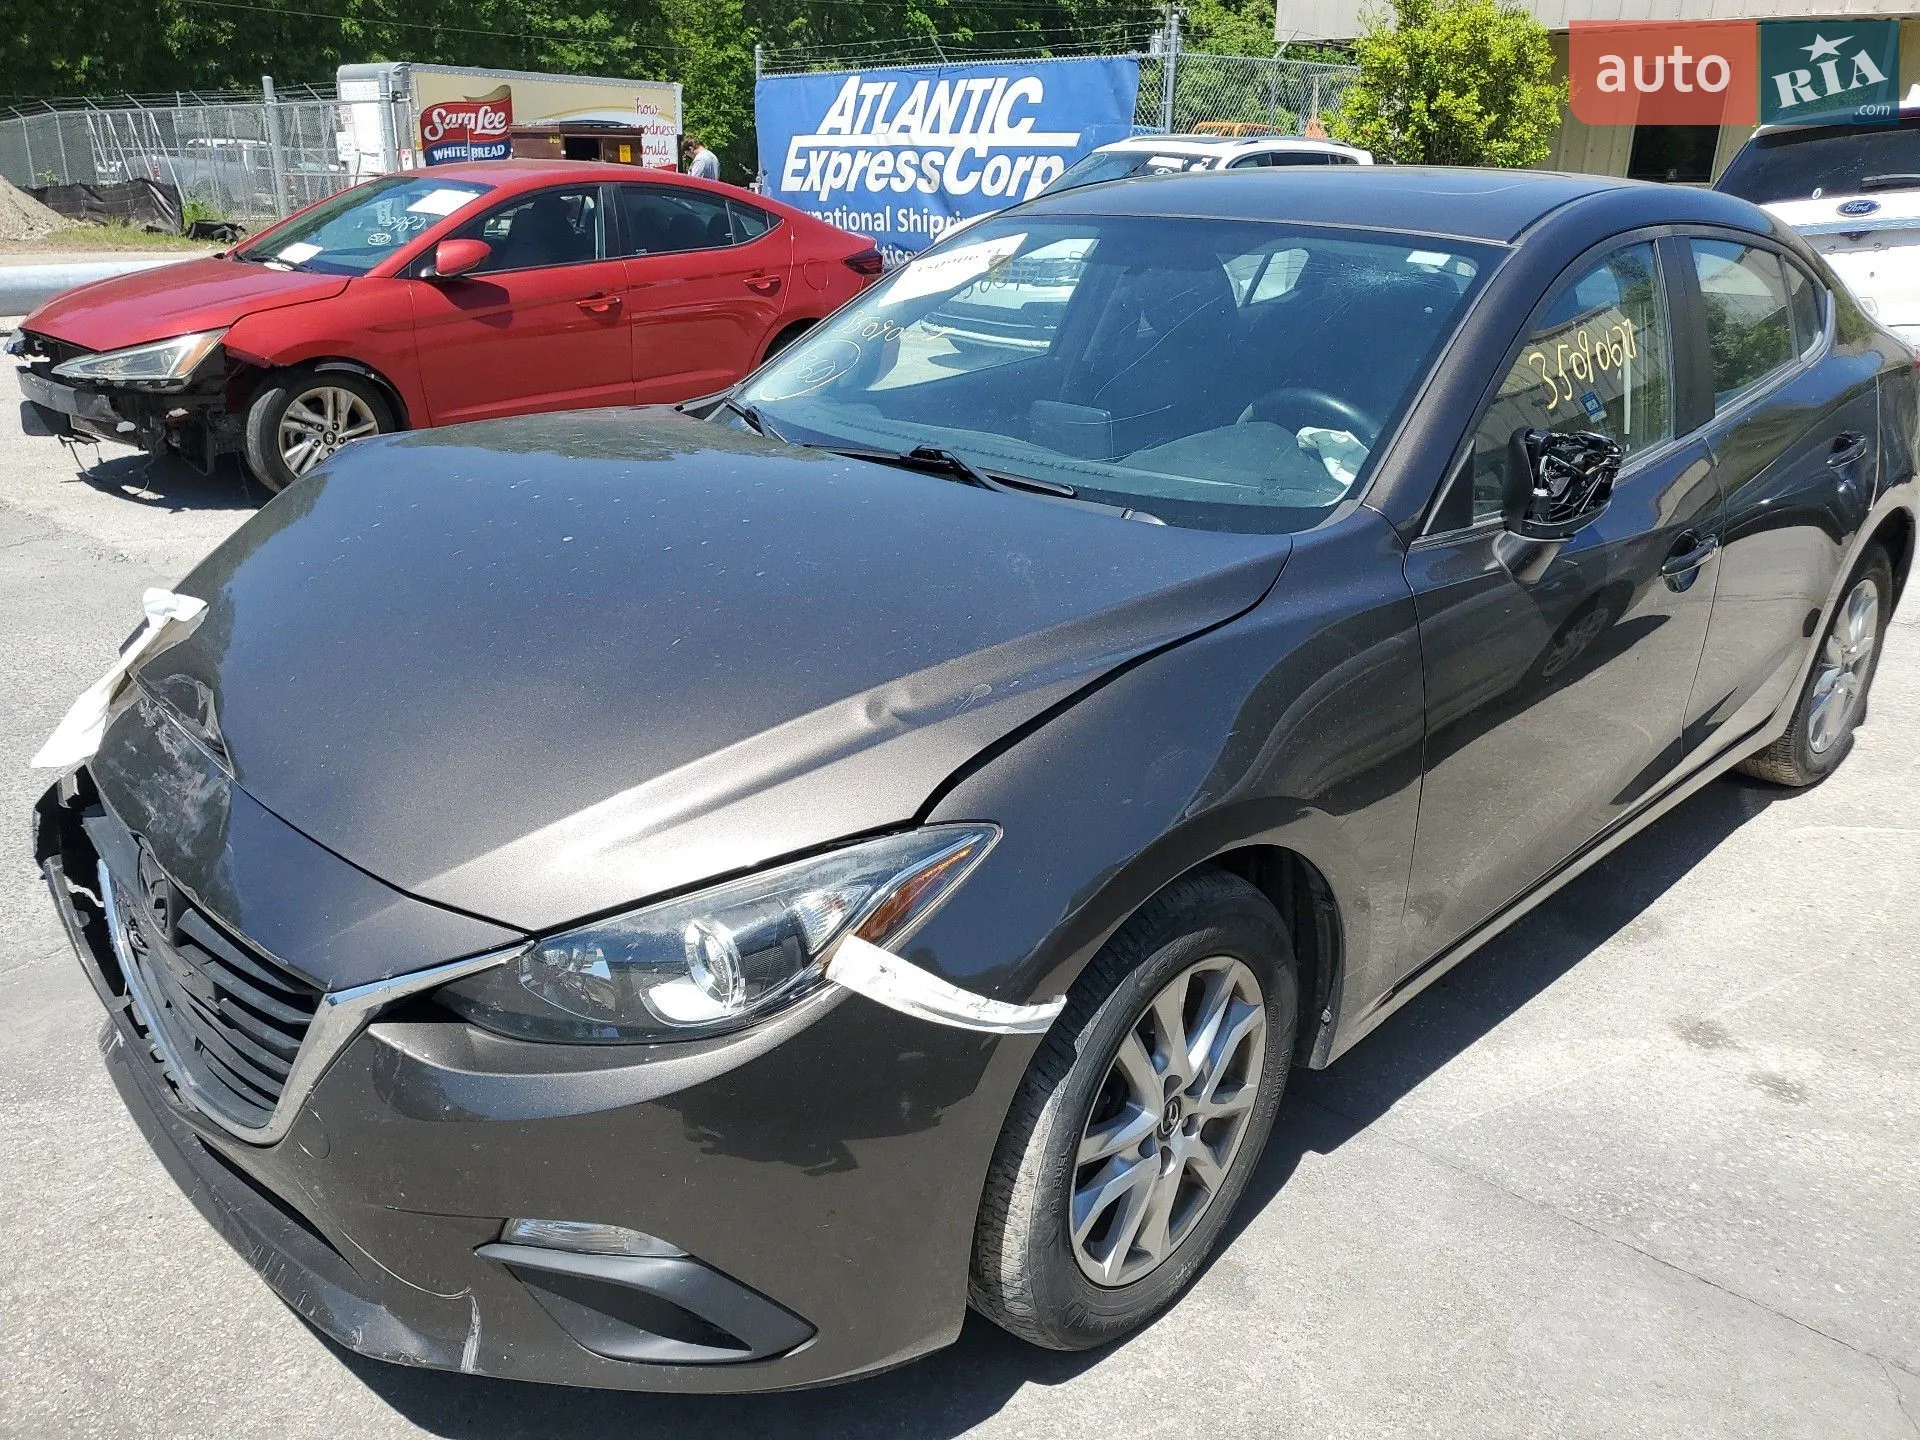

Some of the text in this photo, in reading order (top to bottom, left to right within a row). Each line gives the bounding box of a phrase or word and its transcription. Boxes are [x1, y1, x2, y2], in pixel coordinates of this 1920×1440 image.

[634, 97, 660, 115] how
[816, 75, 1044, 136] ATLANTIC
[632, 119, 676, 136] odness
[432, 144, 505, 161] WHITE BREAD
[642, 140, 669, 156] ould
[1845, 202, 1871, 212] Ford
[805, 205, 891, 232] ational
